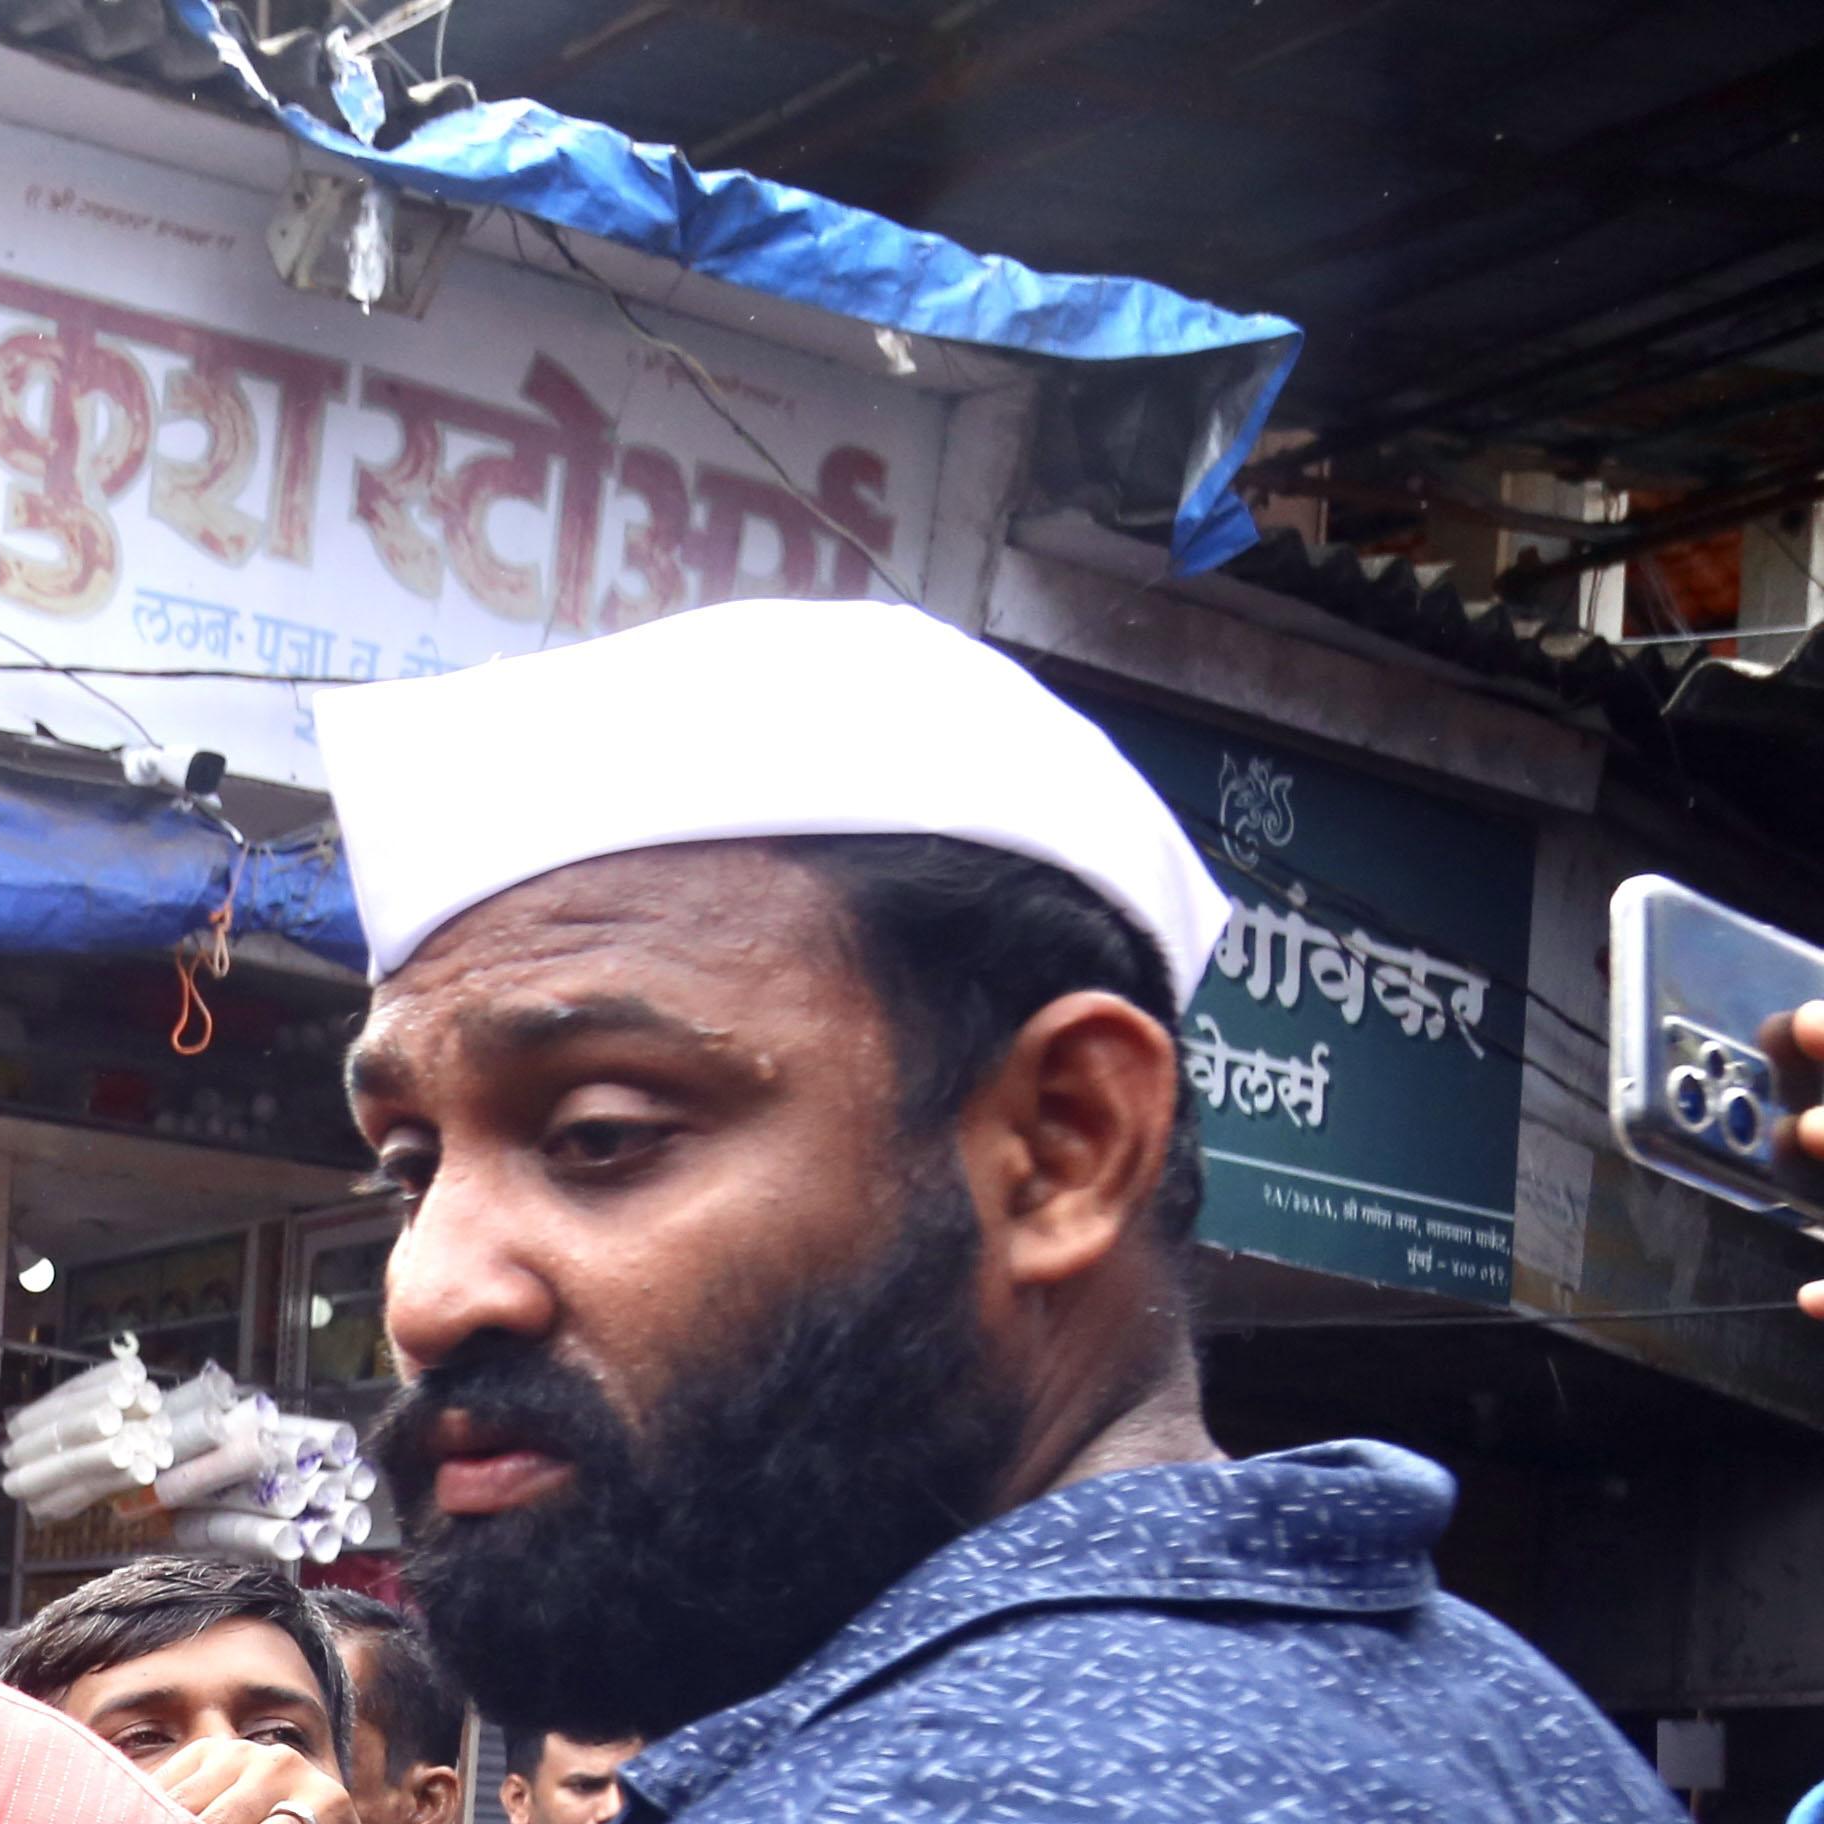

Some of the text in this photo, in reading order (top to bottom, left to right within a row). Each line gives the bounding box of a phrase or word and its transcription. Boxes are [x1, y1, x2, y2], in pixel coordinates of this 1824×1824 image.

[1214, 881, 1491, 1060] गांवकर
[1180, 1013, 1331, 1128] वेलर्स
[1361, 1202, 1393, 1231] गणेश
[1425, 1219, 1473, 1246] लालबाग
[1407, 1244, 1433, 1275] मुंबई
